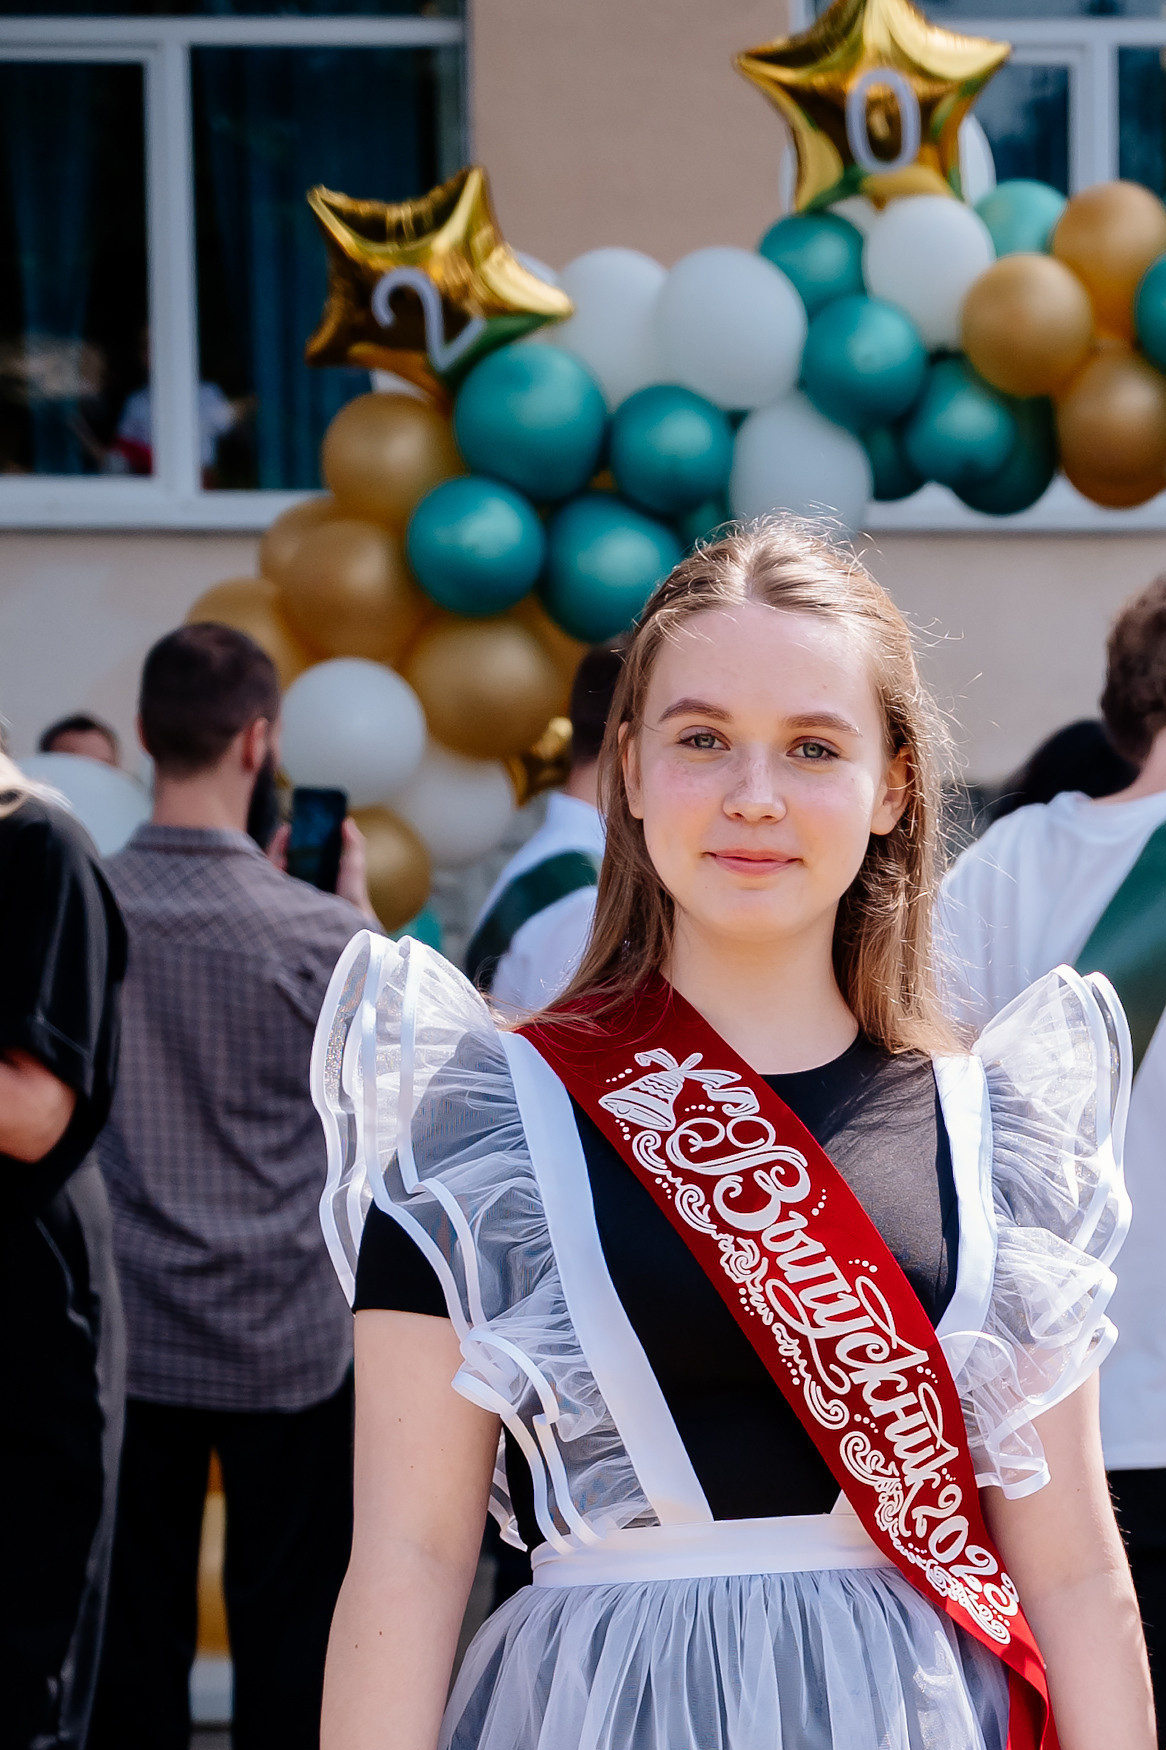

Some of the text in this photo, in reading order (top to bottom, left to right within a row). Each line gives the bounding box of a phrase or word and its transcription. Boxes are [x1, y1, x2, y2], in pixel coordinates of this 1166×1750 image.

[371, 265, 487, 373] 2
[845, 66, 921, 174] 0
[911, 1483, 1020, 1617] 2023
